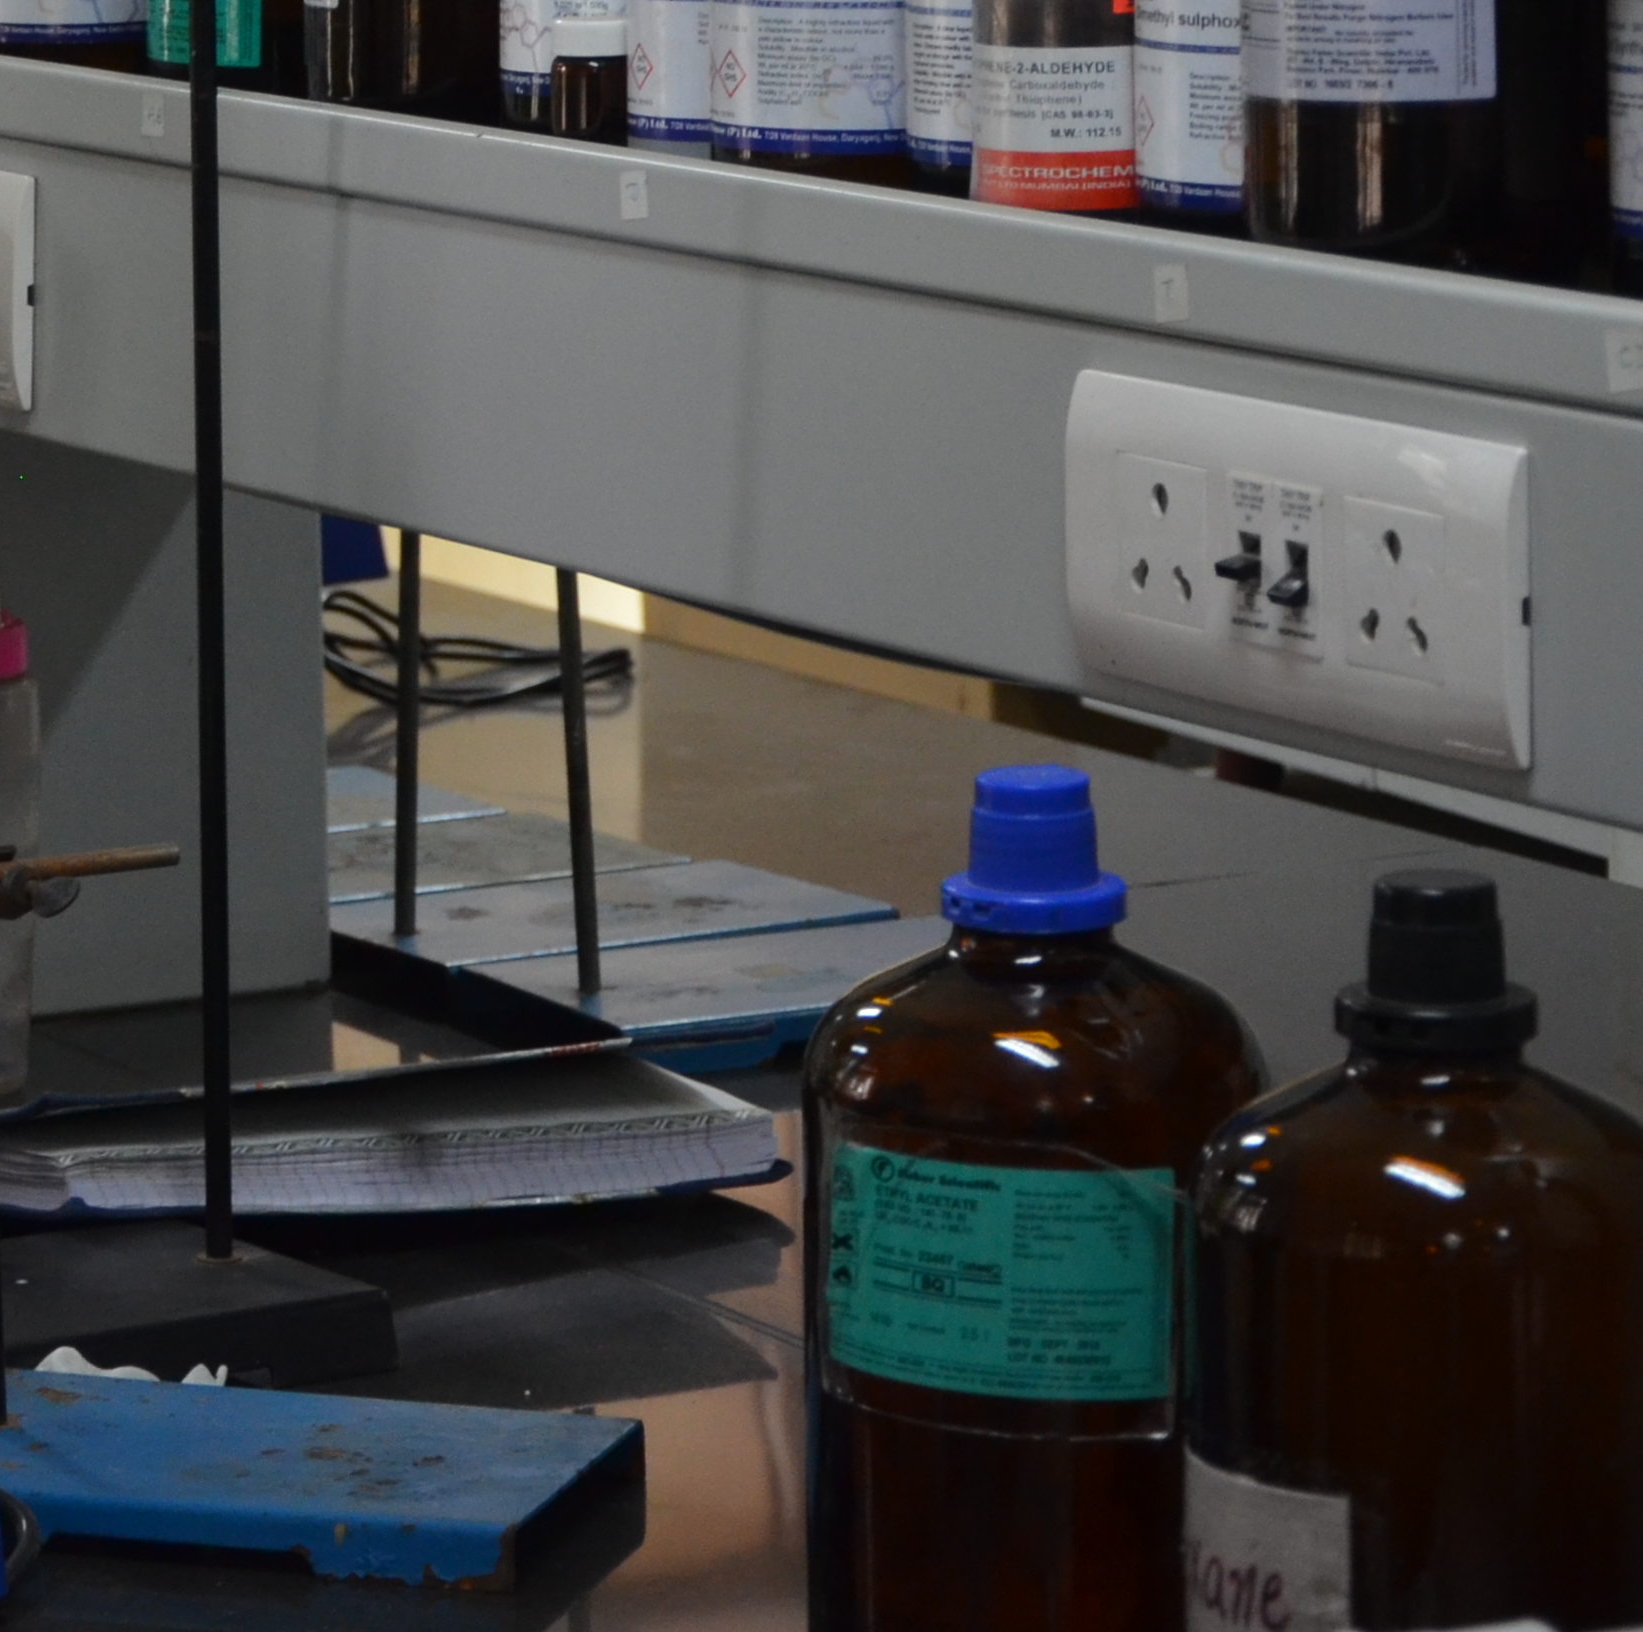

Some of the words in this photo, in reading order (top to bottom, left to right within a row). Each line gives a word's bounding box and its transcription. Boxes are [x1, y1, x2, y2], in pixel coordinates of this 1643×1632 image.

[1009, 79, 1105, 91] Carboxaldehyde
[742, 128, 763, 139] Ltd.
[1086, 126, 1123, 138] 112.15
[917, 1192, 979, 1212] ACETATE
[921, 1273, 945, 1293] SQ
